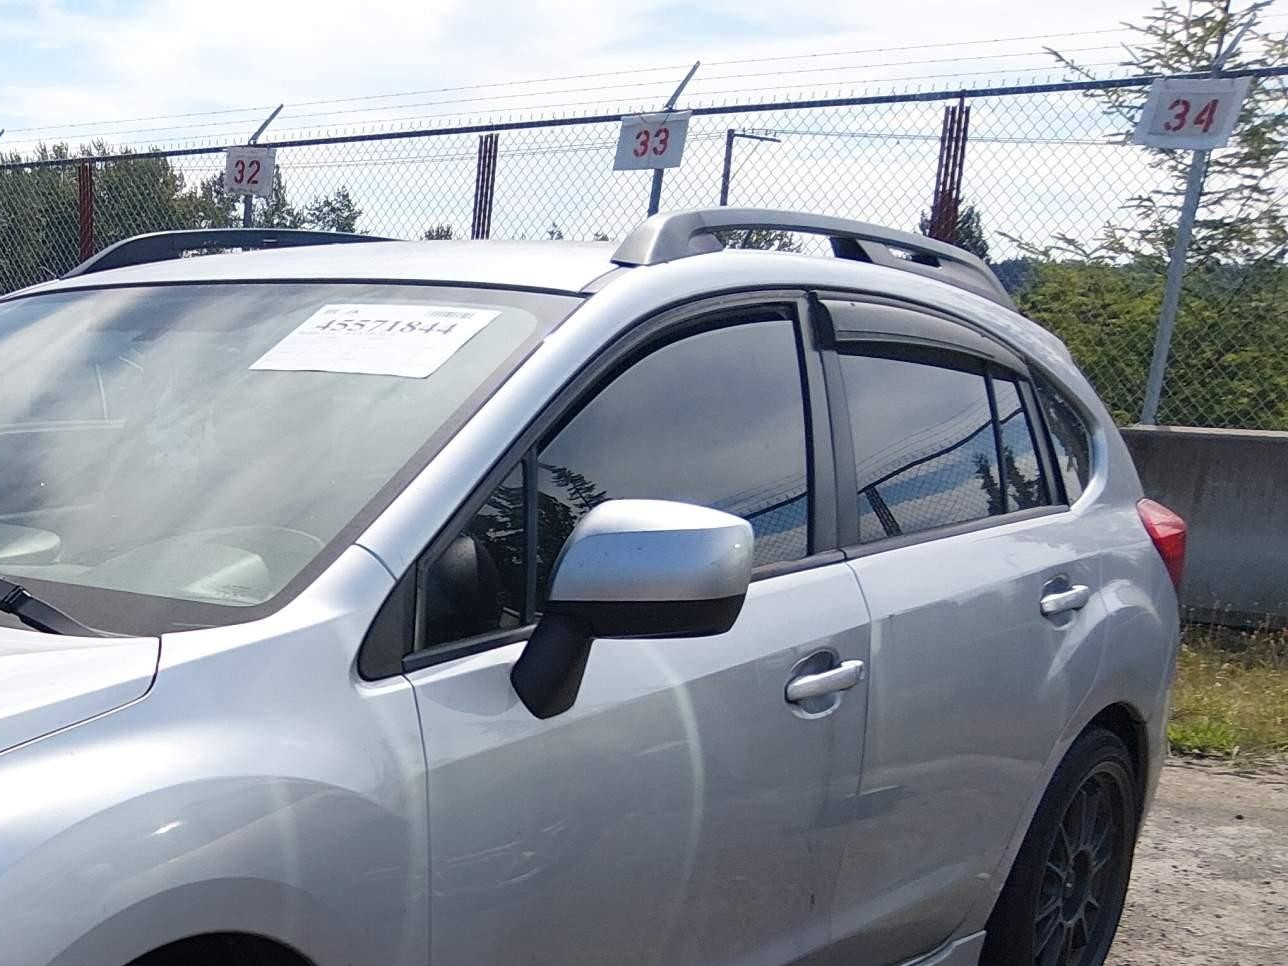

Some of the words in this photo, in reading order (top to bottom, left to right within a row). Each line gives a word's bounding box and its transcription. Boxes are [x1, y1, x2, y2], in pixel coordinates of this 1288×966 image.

[1162, 98, 1220, 133] 34
[633, 127, 670, 158] 33
[233, 159, 261, 184] 32
[314, 319, 458, 335] 45571844
